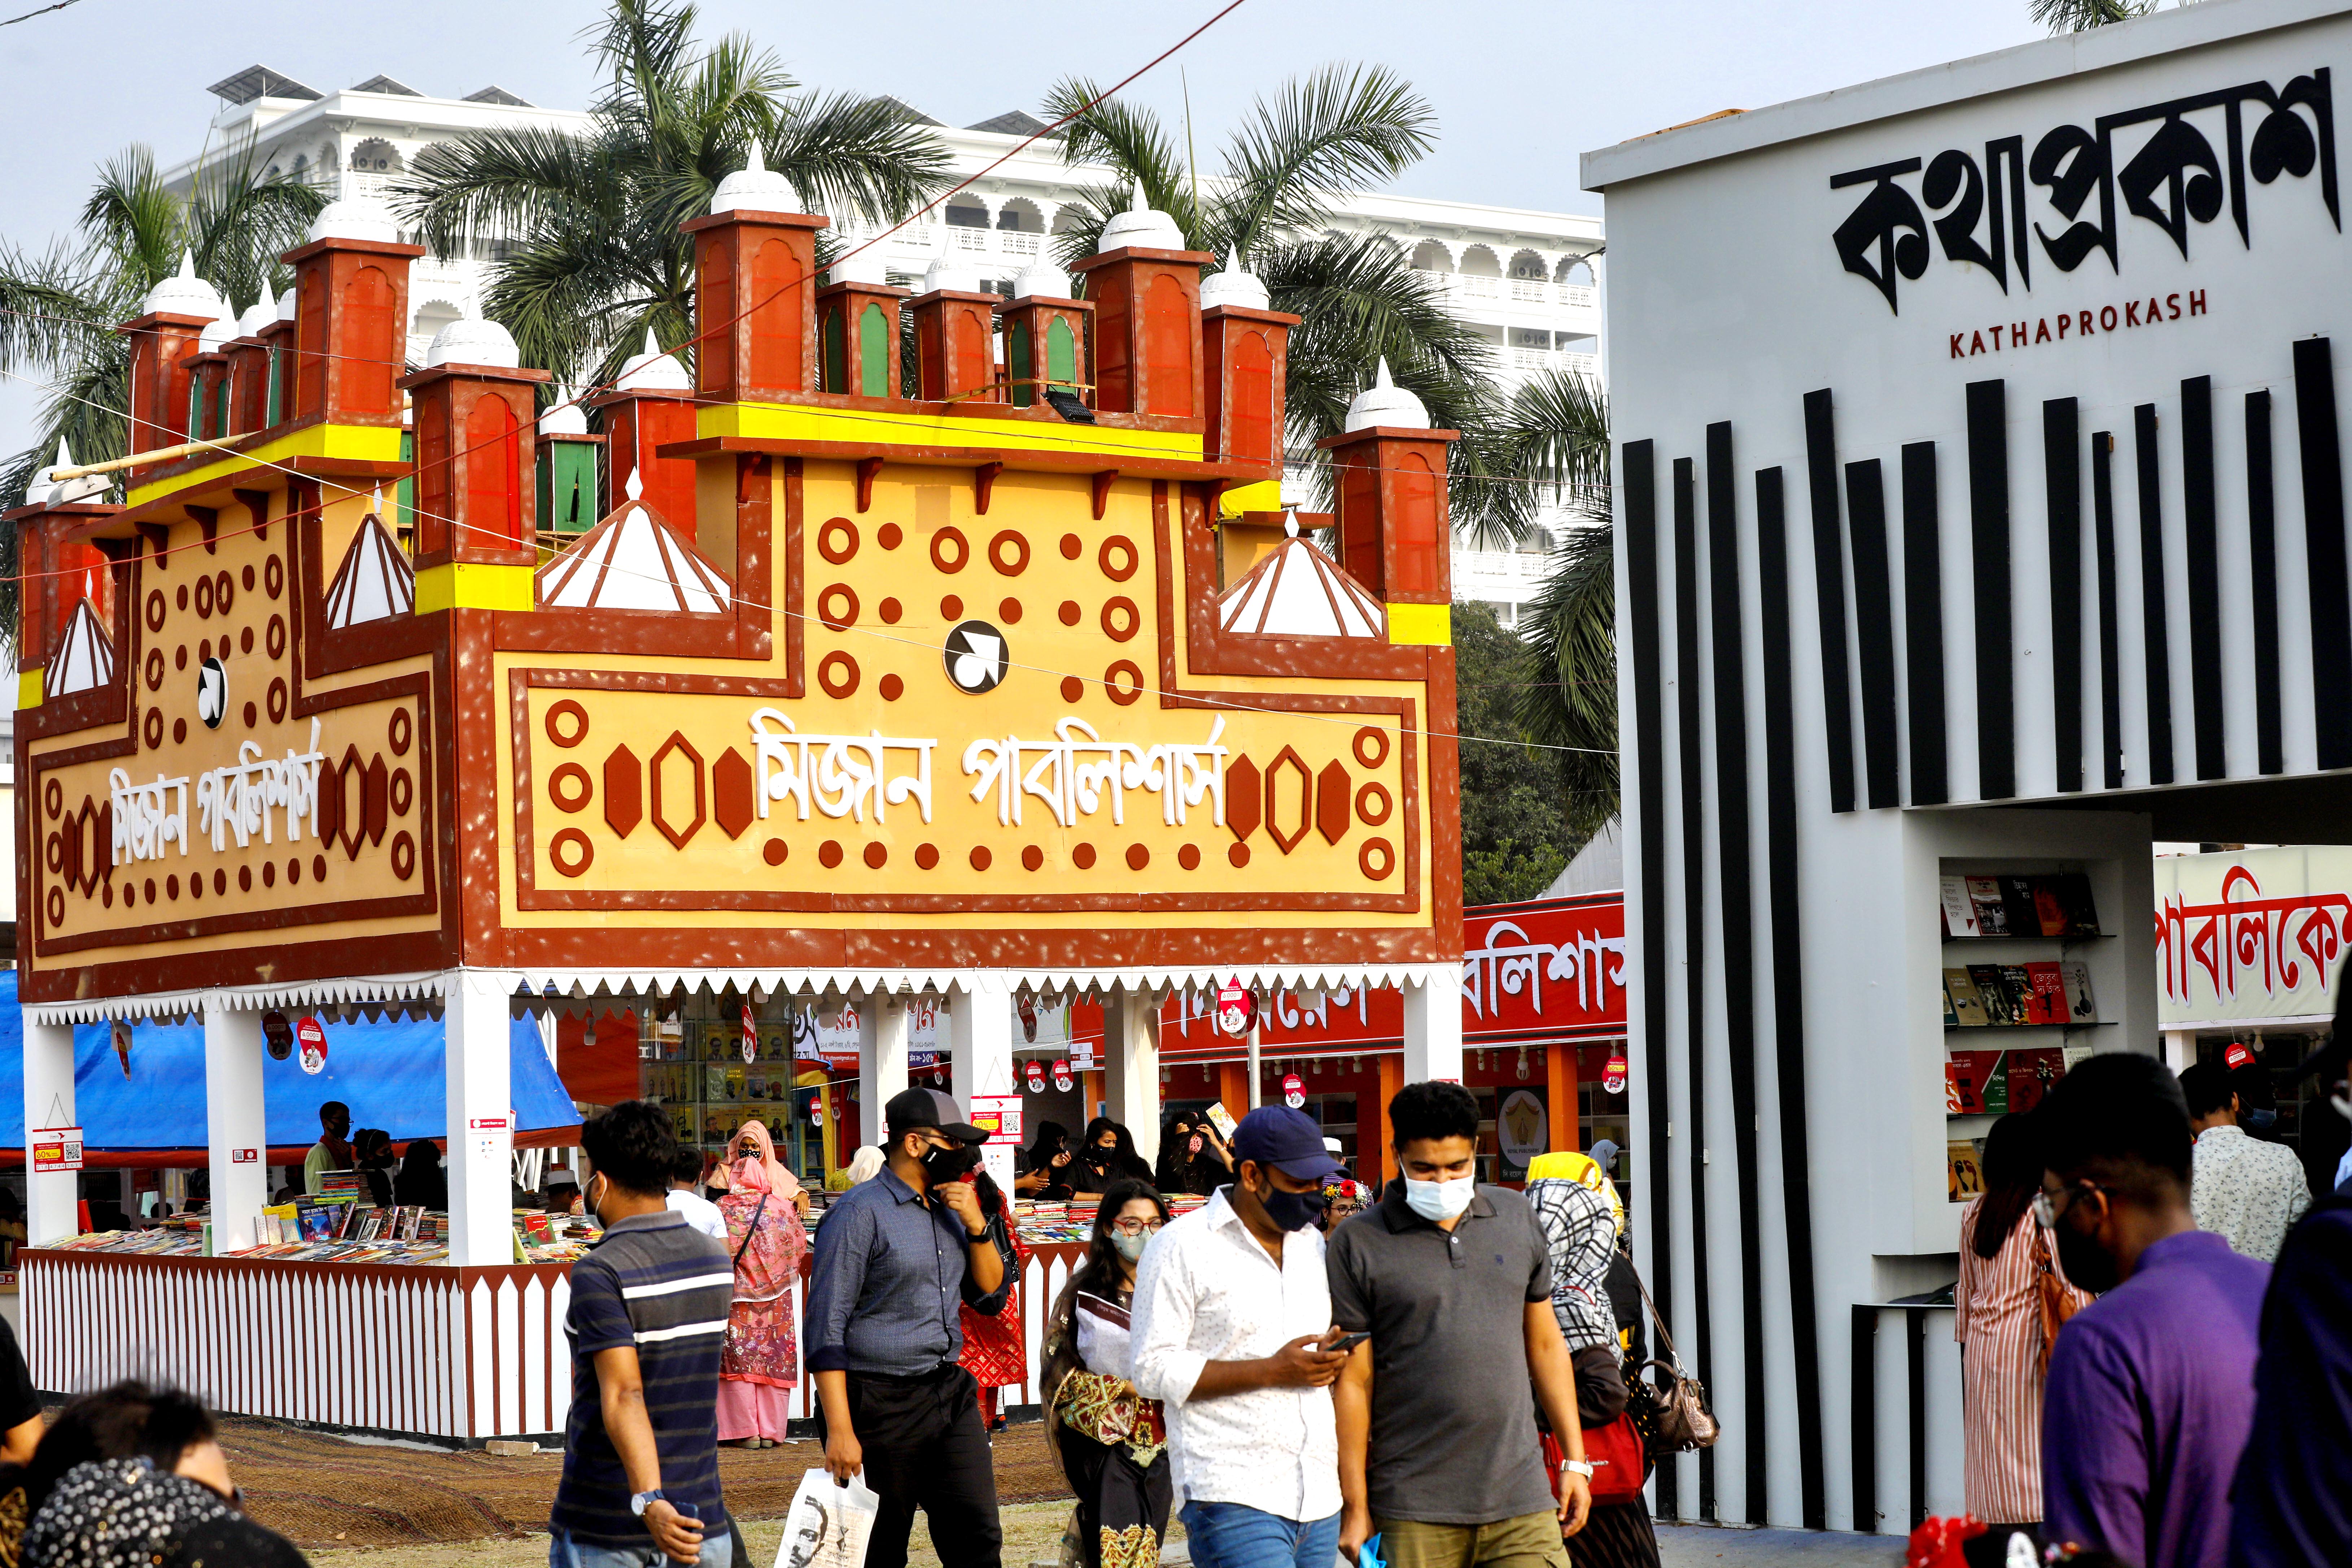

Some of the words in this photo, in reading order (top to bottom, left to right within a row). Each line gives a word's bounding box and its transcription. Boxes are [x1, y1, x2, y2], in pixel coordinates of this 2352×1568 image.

[1829, 66, 2341, 316] কথাপ্রকাশ
[1950, 289, 2207, 358] KATHAPROKASH
[112, 768, 190, 866] মিজান
[197, 716, 324, 852] পাবলিশার্স
[749, 707, 937, 824] মিজান
[962, 713, 1230, 826] পাবলিশার্স
[2034, 974, 2058, 983] জোরবা
[2046, 982, 2060, 994] গ্রিক
[2155, 865, 2352, 1001] পাবলিকে
